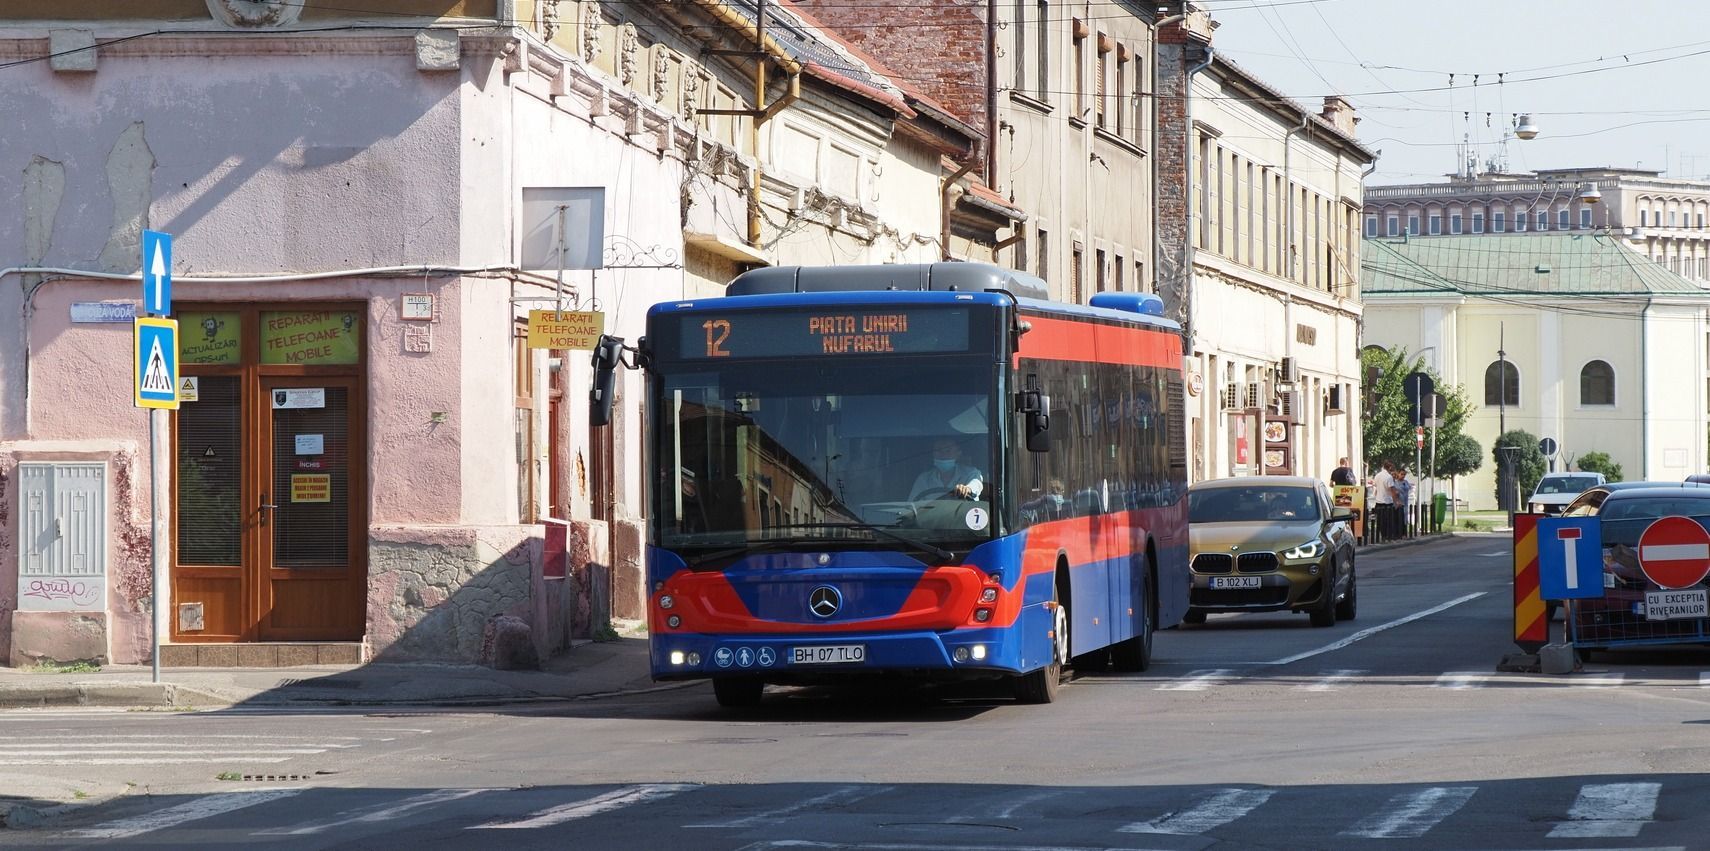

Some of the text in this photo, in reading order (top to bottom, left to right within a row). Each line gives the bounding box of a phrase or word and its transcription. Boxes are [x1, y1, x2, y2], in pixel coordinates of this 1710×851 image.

[541, 313, 593, 325] REARAȚII
[809, 314, 908, 334] PIATA UNIRII
[536, 325, 597, 336] TELEFOANE
[266, 327, 341, 352] TELEFOANE
[549, 337, 588, 347] MOBILE
[703, 319, 730, 357] 12
[823, 334, 894, 353] NUFARUL
[285, 345, 332, 363] MOBILE
[973, 514, 980, 524] 7
[1217, 577, 1259, 587] B 102 XLJ
[1648, 592, 1705, 605] CU EXCEPTIA
[1650, 604, 1705, 617] RIVERANILOR
[795, 648, 814, 662] BH
[818, 648, 834, 661] 07
[837, 647, 863, 661] TLO
